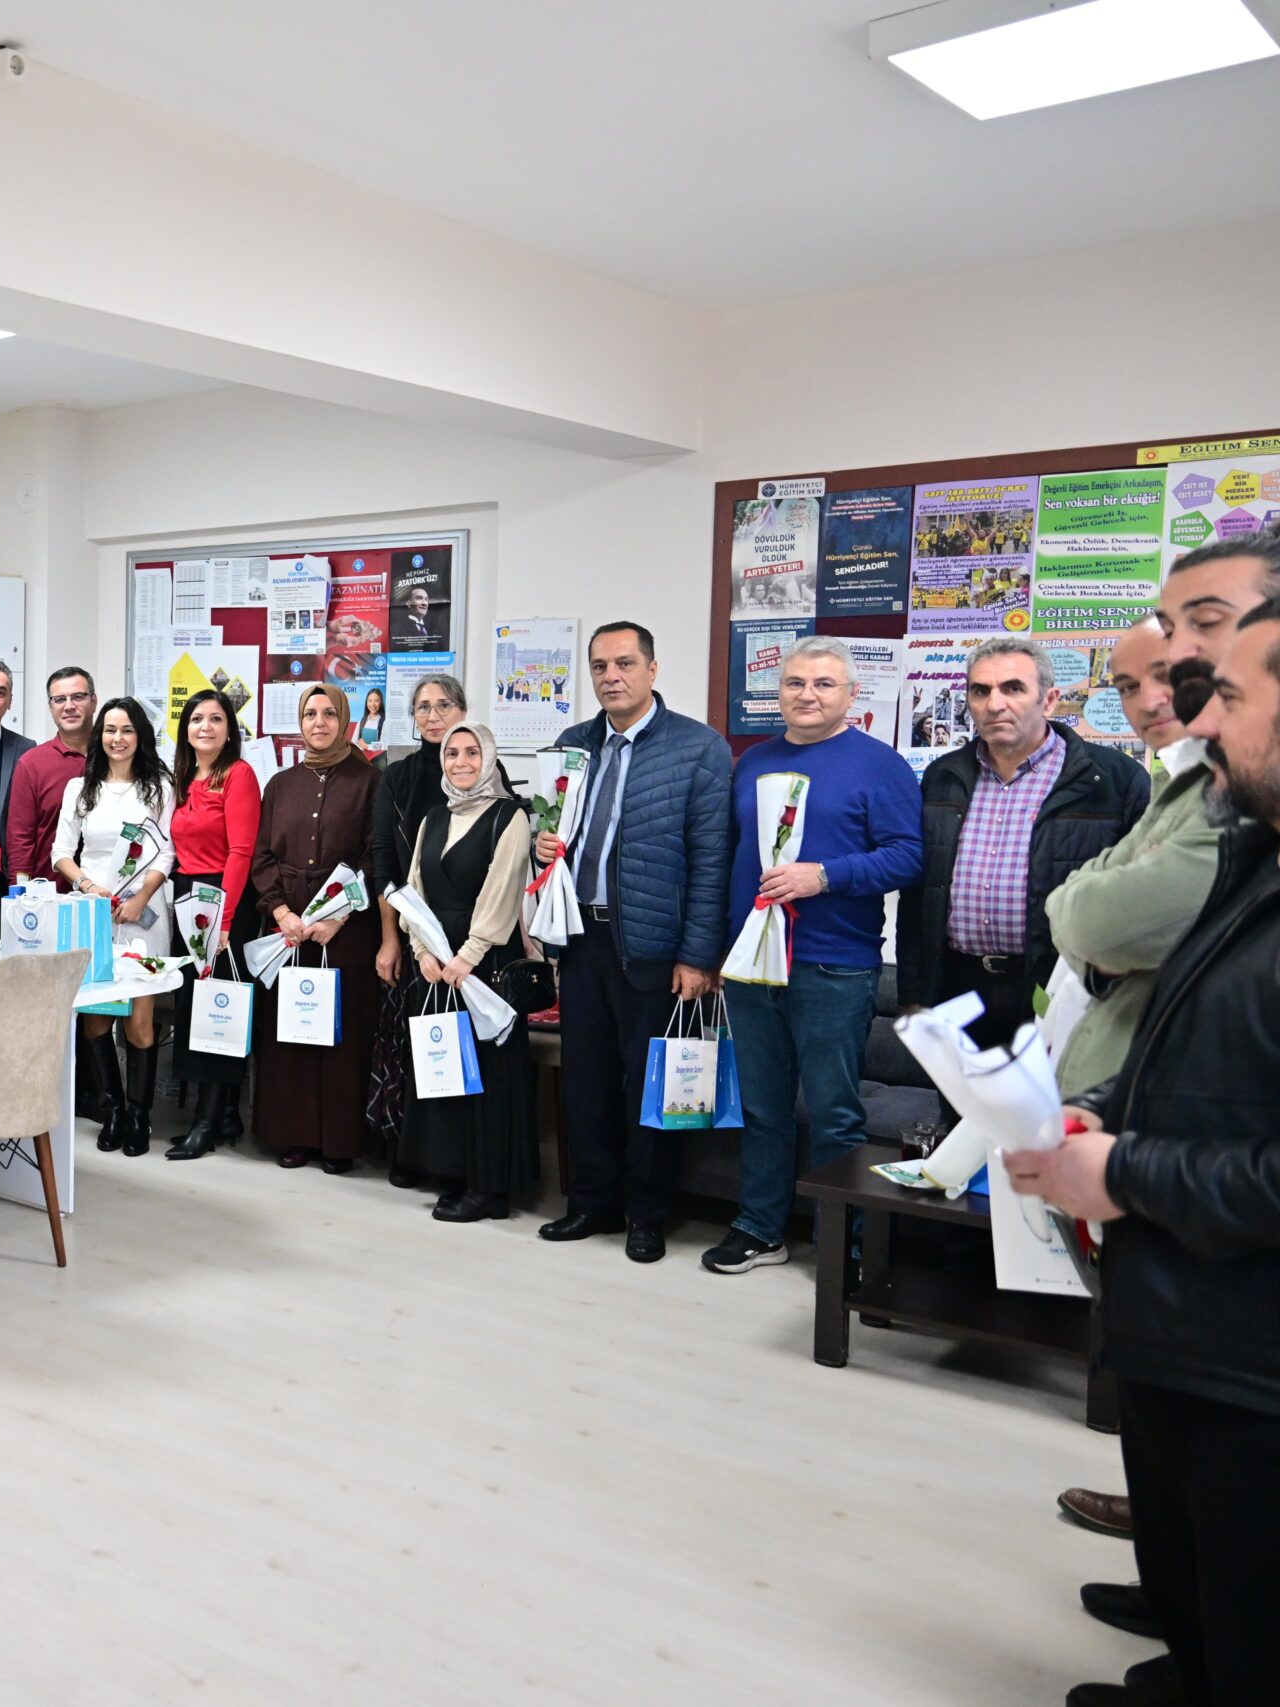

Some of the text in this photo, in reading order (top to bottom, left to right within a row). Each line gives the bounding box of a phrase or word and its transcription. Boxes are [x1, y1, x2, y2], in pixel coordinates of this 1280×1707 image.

[1180, 441, 1241, 454] EĞİTİM
[779, 489, 805, 497] EĞİTİM
[1044, 492, 1161, 510] Sen yoksan bir eksiğiz!
[754, 533, 796, 544] DÖVÜLDÜK
[754, 544, 796, 553] VURULDUK
[761, 554, 787, 562] ÖLDÜK
[825, 553, 859, 562] Hürriyetçi
[860, 552, 882, 560] Eğitim
[746, 562, 801, 578] ARTIK YETER!
[834, 561, 889, 576] SENDİKADIR!
[1036, 606, 1094, 618] EĞİTİM
[758, 648, 778, 658] KABUL
